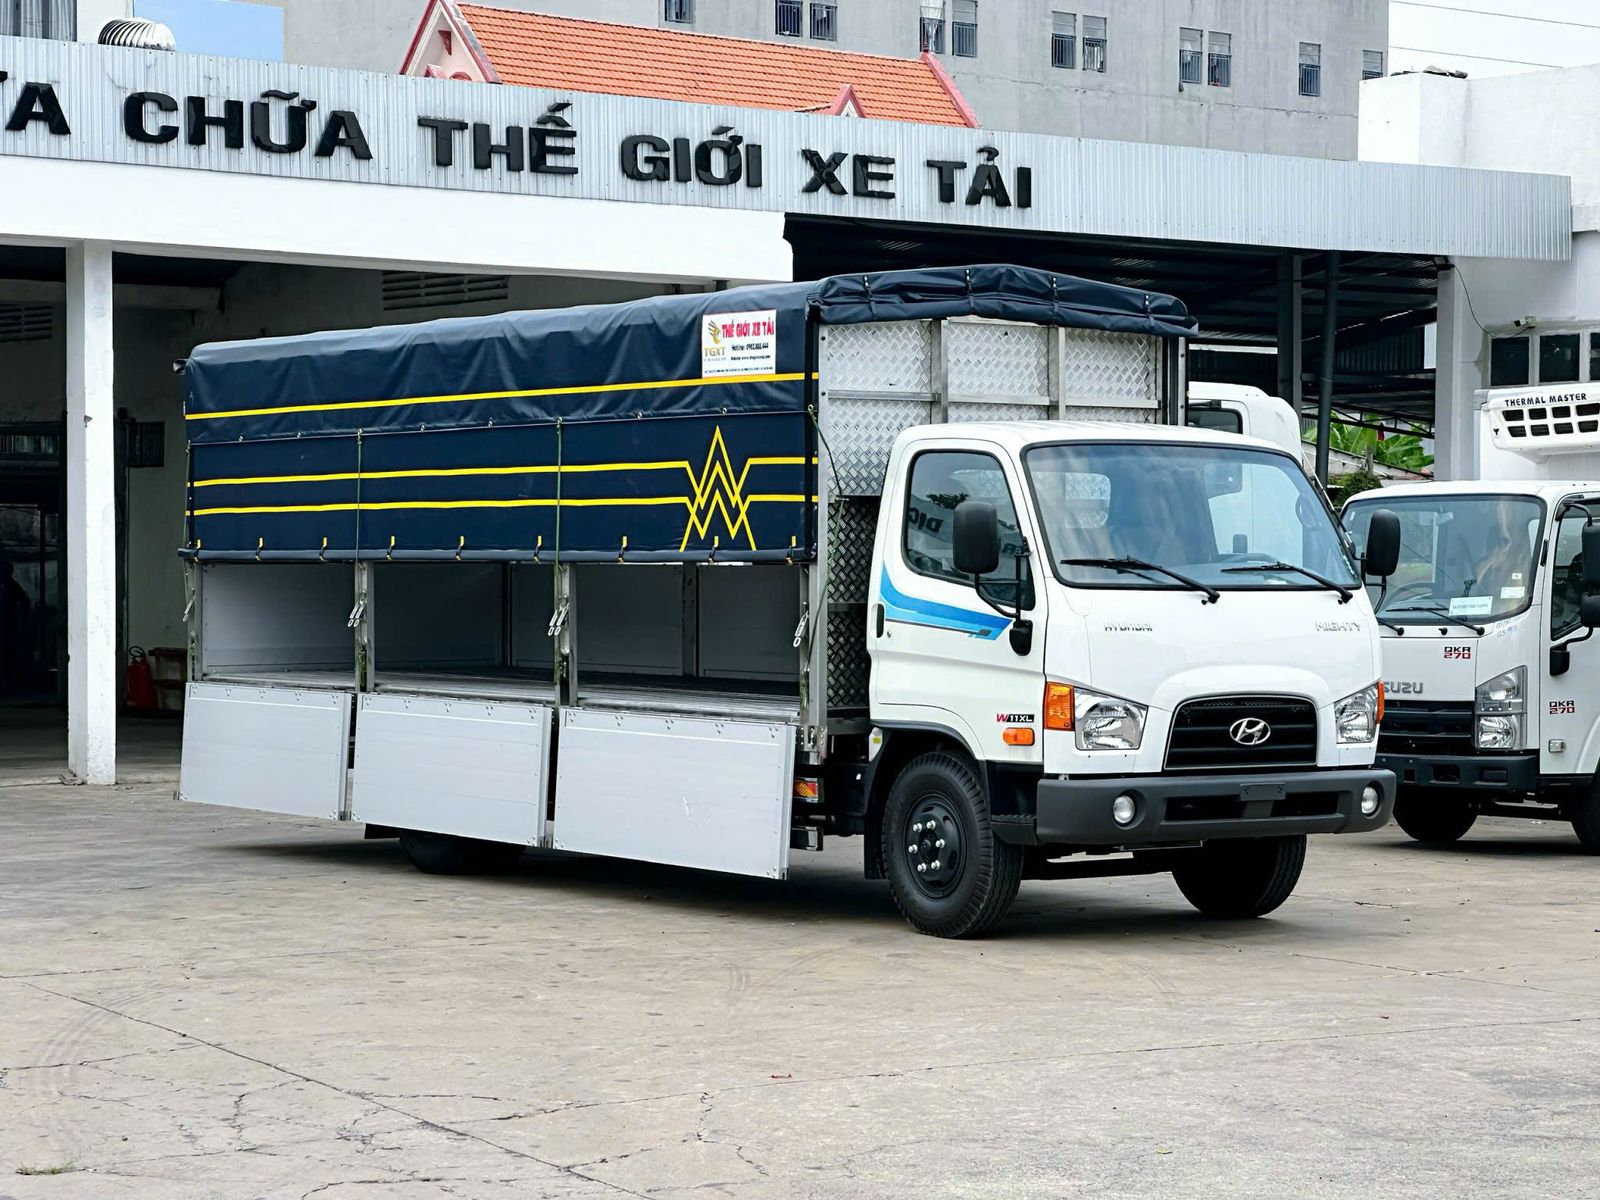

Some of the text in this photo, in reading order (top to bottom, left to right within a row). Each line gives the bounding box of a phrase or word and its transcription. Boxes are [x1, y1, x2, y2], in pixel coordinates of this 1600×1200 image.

[0, 71, 1032, 210] A CHỮA THẾ GIỚI XE TẢI
[752, 321, 761, 336] XE
[762, 317, 775, 336] TẢI
[704, 346, 726, 357] TGXT
[1505, 392, 1588, 407] THERMAL MASTER
[1383, 681, 1424, 694] SUZU
[996, 713, 1035, 723] W11XL
